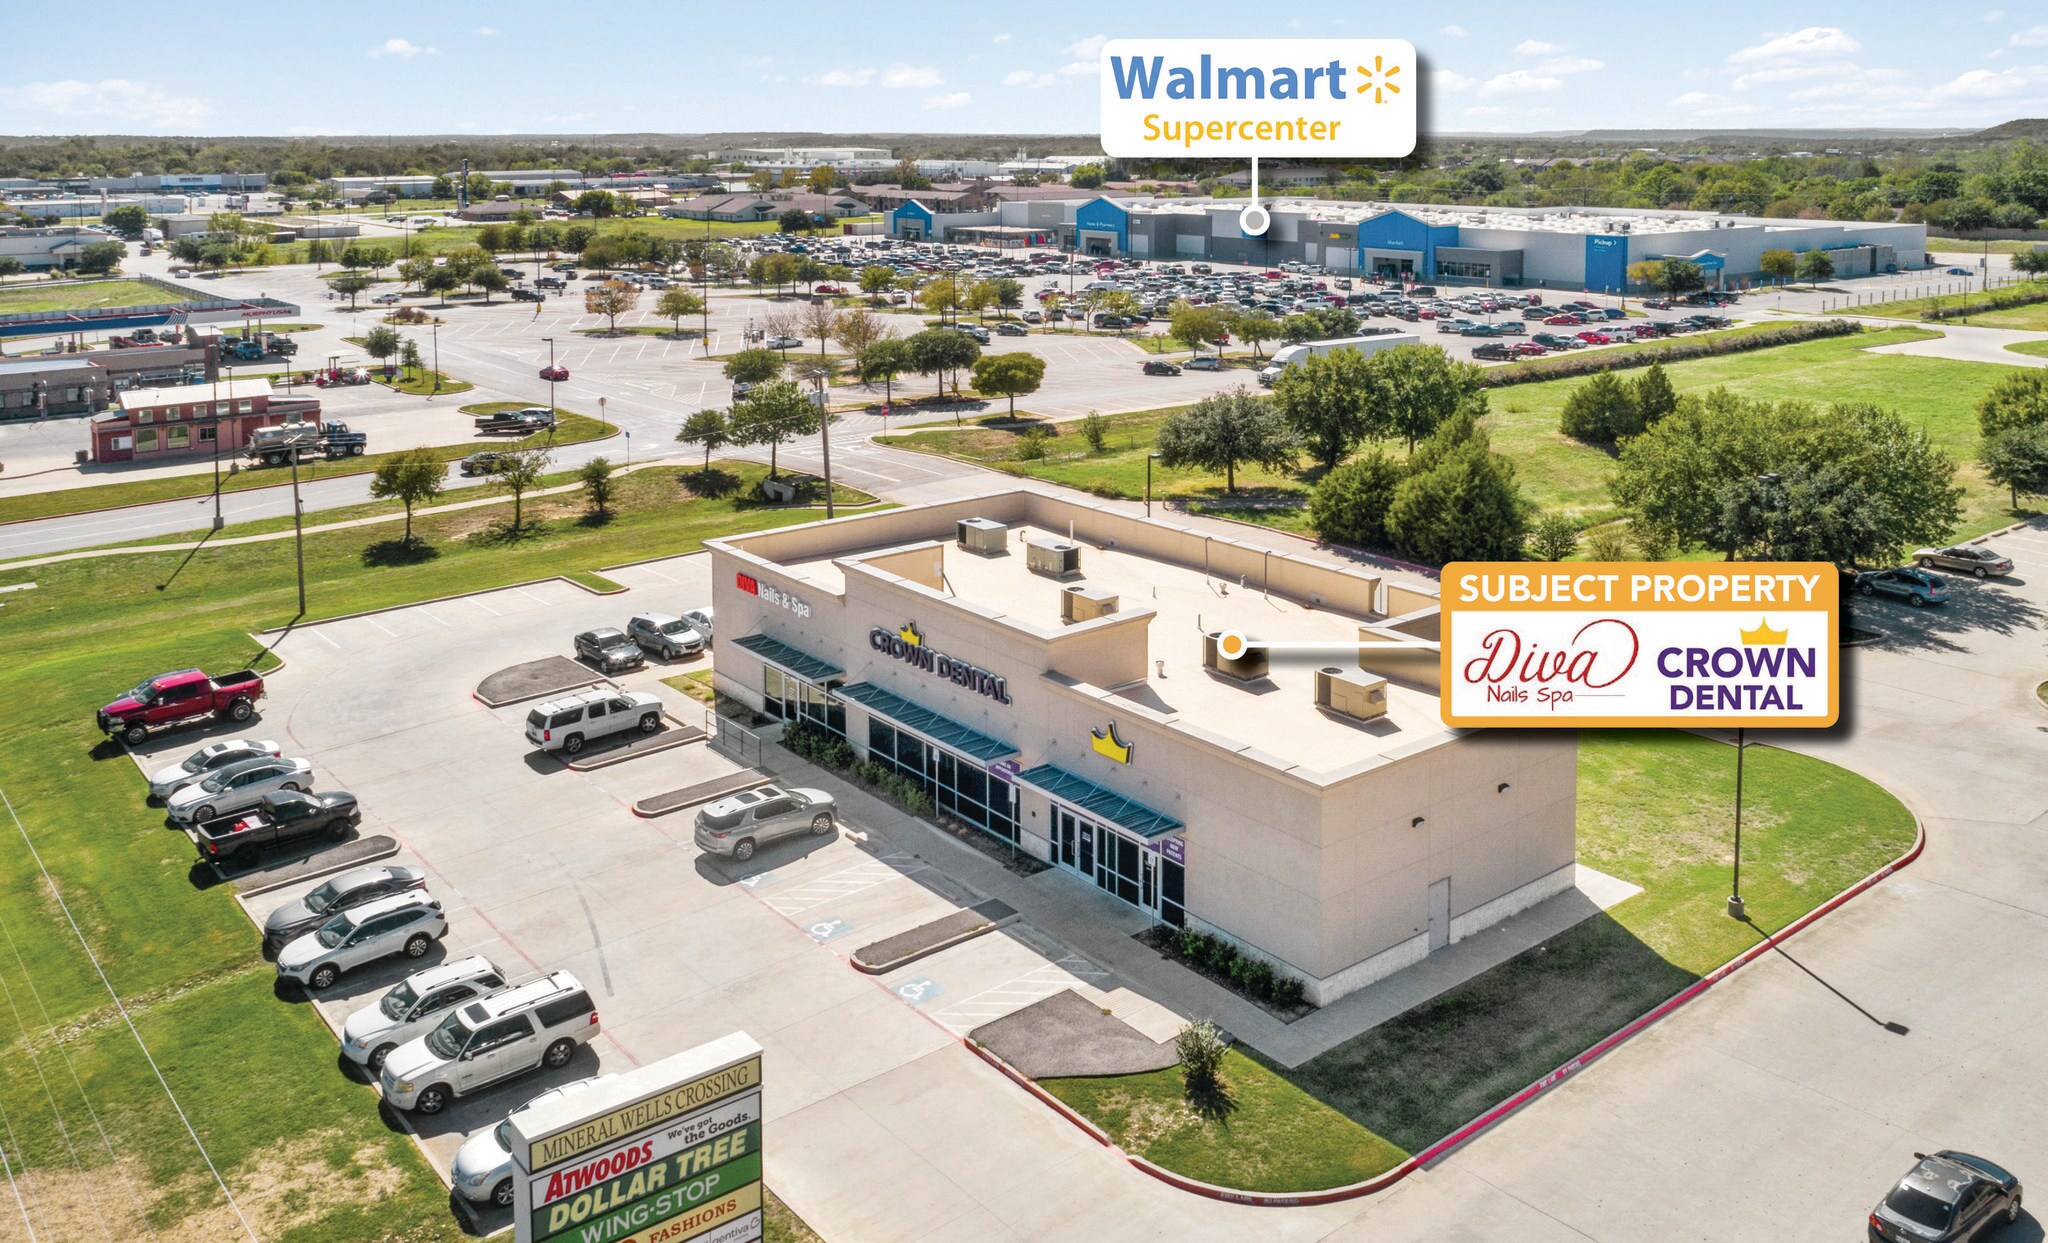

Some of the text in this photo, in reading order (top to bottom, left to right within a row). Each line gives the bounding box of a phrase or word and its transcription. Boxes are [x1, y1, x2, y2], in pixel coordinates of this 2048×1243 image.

[1594, 238, 1612, 246] Pickup
[736, 572, 810, 618] DIVA Nails & Spa
[869, 627, 1012, 706] CROWN DENTAL
[542, 1066, 749, 1163] MINERAL WELLS CROSSING
[667, 1116, 713, 1140] We've got
[684, 1111, 751, 1145] the Goods.
[543, 1140, 654, 1204] ATWOODS
[548, 1128, 749, 1233] DOLLAR TREE
[649, 1199, 738, 1243] FASHIONS
